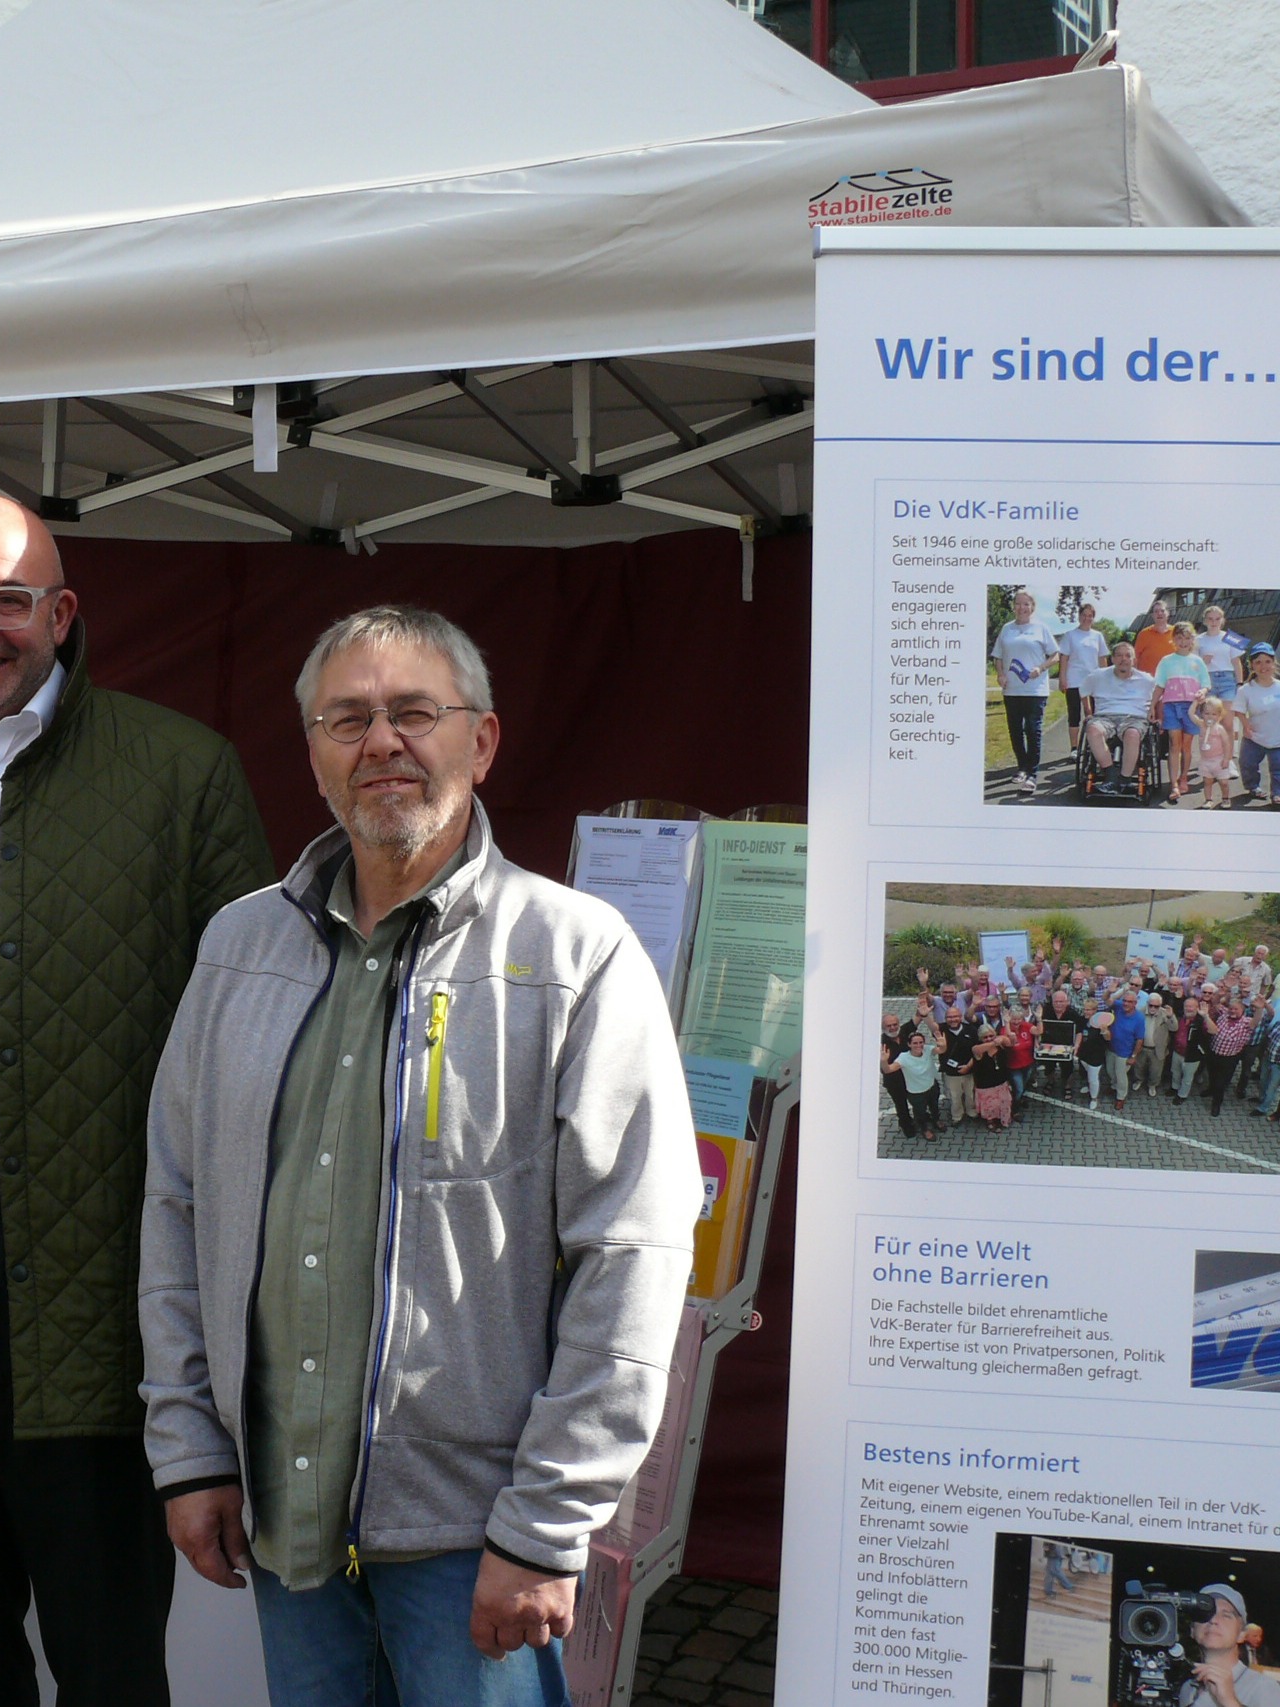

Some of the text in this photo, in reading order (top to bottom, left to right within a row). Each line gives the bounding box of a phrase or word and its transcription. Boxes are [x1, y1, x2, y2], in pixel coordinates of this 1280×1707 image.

[875, 337, 1275, 382] Wir sind der...
[894, 500, 1079, 520] Die VdK-Familie
[892, 535, 917, 548] Seit
[922, 536, 956, 548] 1946
[961, 537, 989, 549] eine
[994, 536, 1033, 552] große
[1037, 538, 1115, 551] solidarische
[892, 554, 1200, 571] Gemeinsame Aktivitäten, echtes Miteinander.
[892, 581, 954, 594] Tausende
[891, 601, 966, 615] engagieren
[891, 618, 965, 631] sich ehren-
[891, 636, 961, 649] amtlich im
[891, 655, 947, 668] Verband
[891, 672, 950, 686] für Men-
[890, 691, 957, 707] schen, für
[890, 711, 934, 723] soziale
[890, 729, 960, 745] Gerechtig-
[889, 747, 916, 761] keit.
[722, 839, 786, 854] INFO-DIENST
[874, 1236, 1031, 1262] Für eine Welt
[873, 1263, 1049, 1289] ohne Barrieren
[871, 1298, 1108, 1322] Die Fachstelle bildet ehrenamtliche
[870, 1317, 1112, 1341] VdK-Berater für Barrierefreiheit aus.
[869, 1335, 1165, 1363] Ihre Expertise ist von Privatpersonen, Politik
[868, 1354, 1142, 1383] und Verwaltung gleichermaßen gefragt.
[864, 1442, 1080, 1473] Bestens informiert
[862, 1478, 1266, 1516] Mit eigener Website, einem redaktionellen Teil in der VdK-
[860, 1496, 915, 1514] Zeitung,
[921, 1500, 962, 1514] einem
[967, 1503, 1021, 1520] eigenen
[1026, 1507, 1133, 1527] YouTube-Kanal,
[1139, 1513, 1182, 1529] einem
[1187, 1517, 1243, 1533] Intranet
[1248, 1521, 1268, 1535] für
[860, 1515, 968, 1534] Ehrenamt sowie
[858, 1534, 949, 1551] einer Vielzahl
[858, 1553, 955, 1570] an Broschüren
[857, 1571, 967, 1589] und Infoblättern
[856, 1588, 928, 1605] gelingt die
[855, 1606, 964, 1626] Kommunikation
[854, 1624, 935, 1642] mit den fast
[853, 1642, 967, 1664] 300.000 Mitglie-
[852, 1660, 952, 1679] dern in Hessen
[851, 1678, 955, 1699] und Thüringen.
